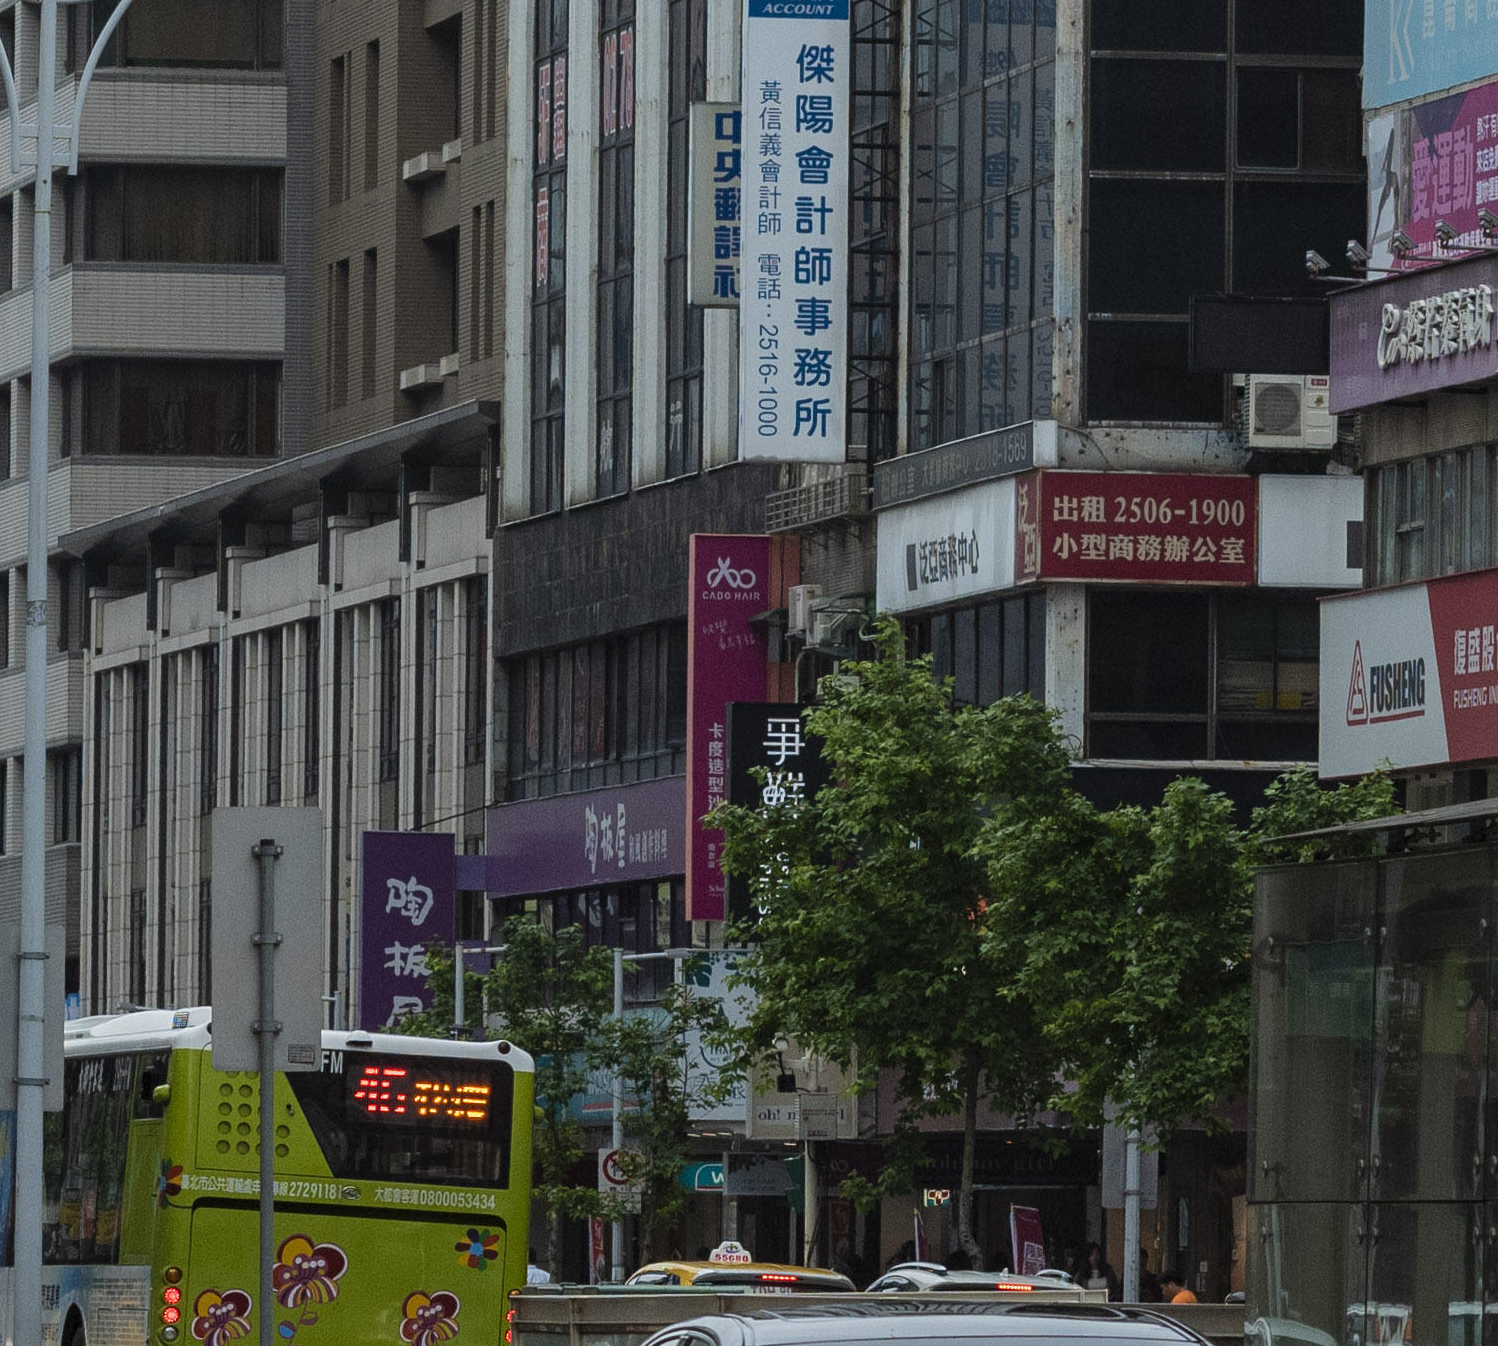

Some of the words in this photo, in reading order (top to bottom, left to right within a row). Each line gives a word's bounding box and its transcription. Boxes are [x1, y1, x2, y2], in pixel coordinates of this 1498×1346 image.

[762, 4, 835, 15] ACCOUNT
[757, 79, 783, 236] 黃信義會計師
[1412, 125, 1475, 222] 愛運動
[792, 44, 836, 438] 傑陽會計師事務所
[1053, 495, 1107, 523] 出租
[1114, 495, 1246, 527] 2506-1900
[918, 528, 980, 586] 泛亞商務中心
[1052, 534, 1246, 565] 小型商務辦公室
[702, 591, 732, 601] CADO
[734, 590, 761, 601] HAIR
[1368, 657, 1426, 711] FUSHENG
[1453, 683, 1487, 710] FUSHENG
[584, 802, 627, 875] 陶板屋
[320, 1050, 344, 1075] FM
[757, 1107, 780, 1121] oh!
[289, 1181, 344, 1201] 27291181
[373, 1187, 420, 1204] 大都會客運
[419, 1189, 497, 1210] 0800053434
